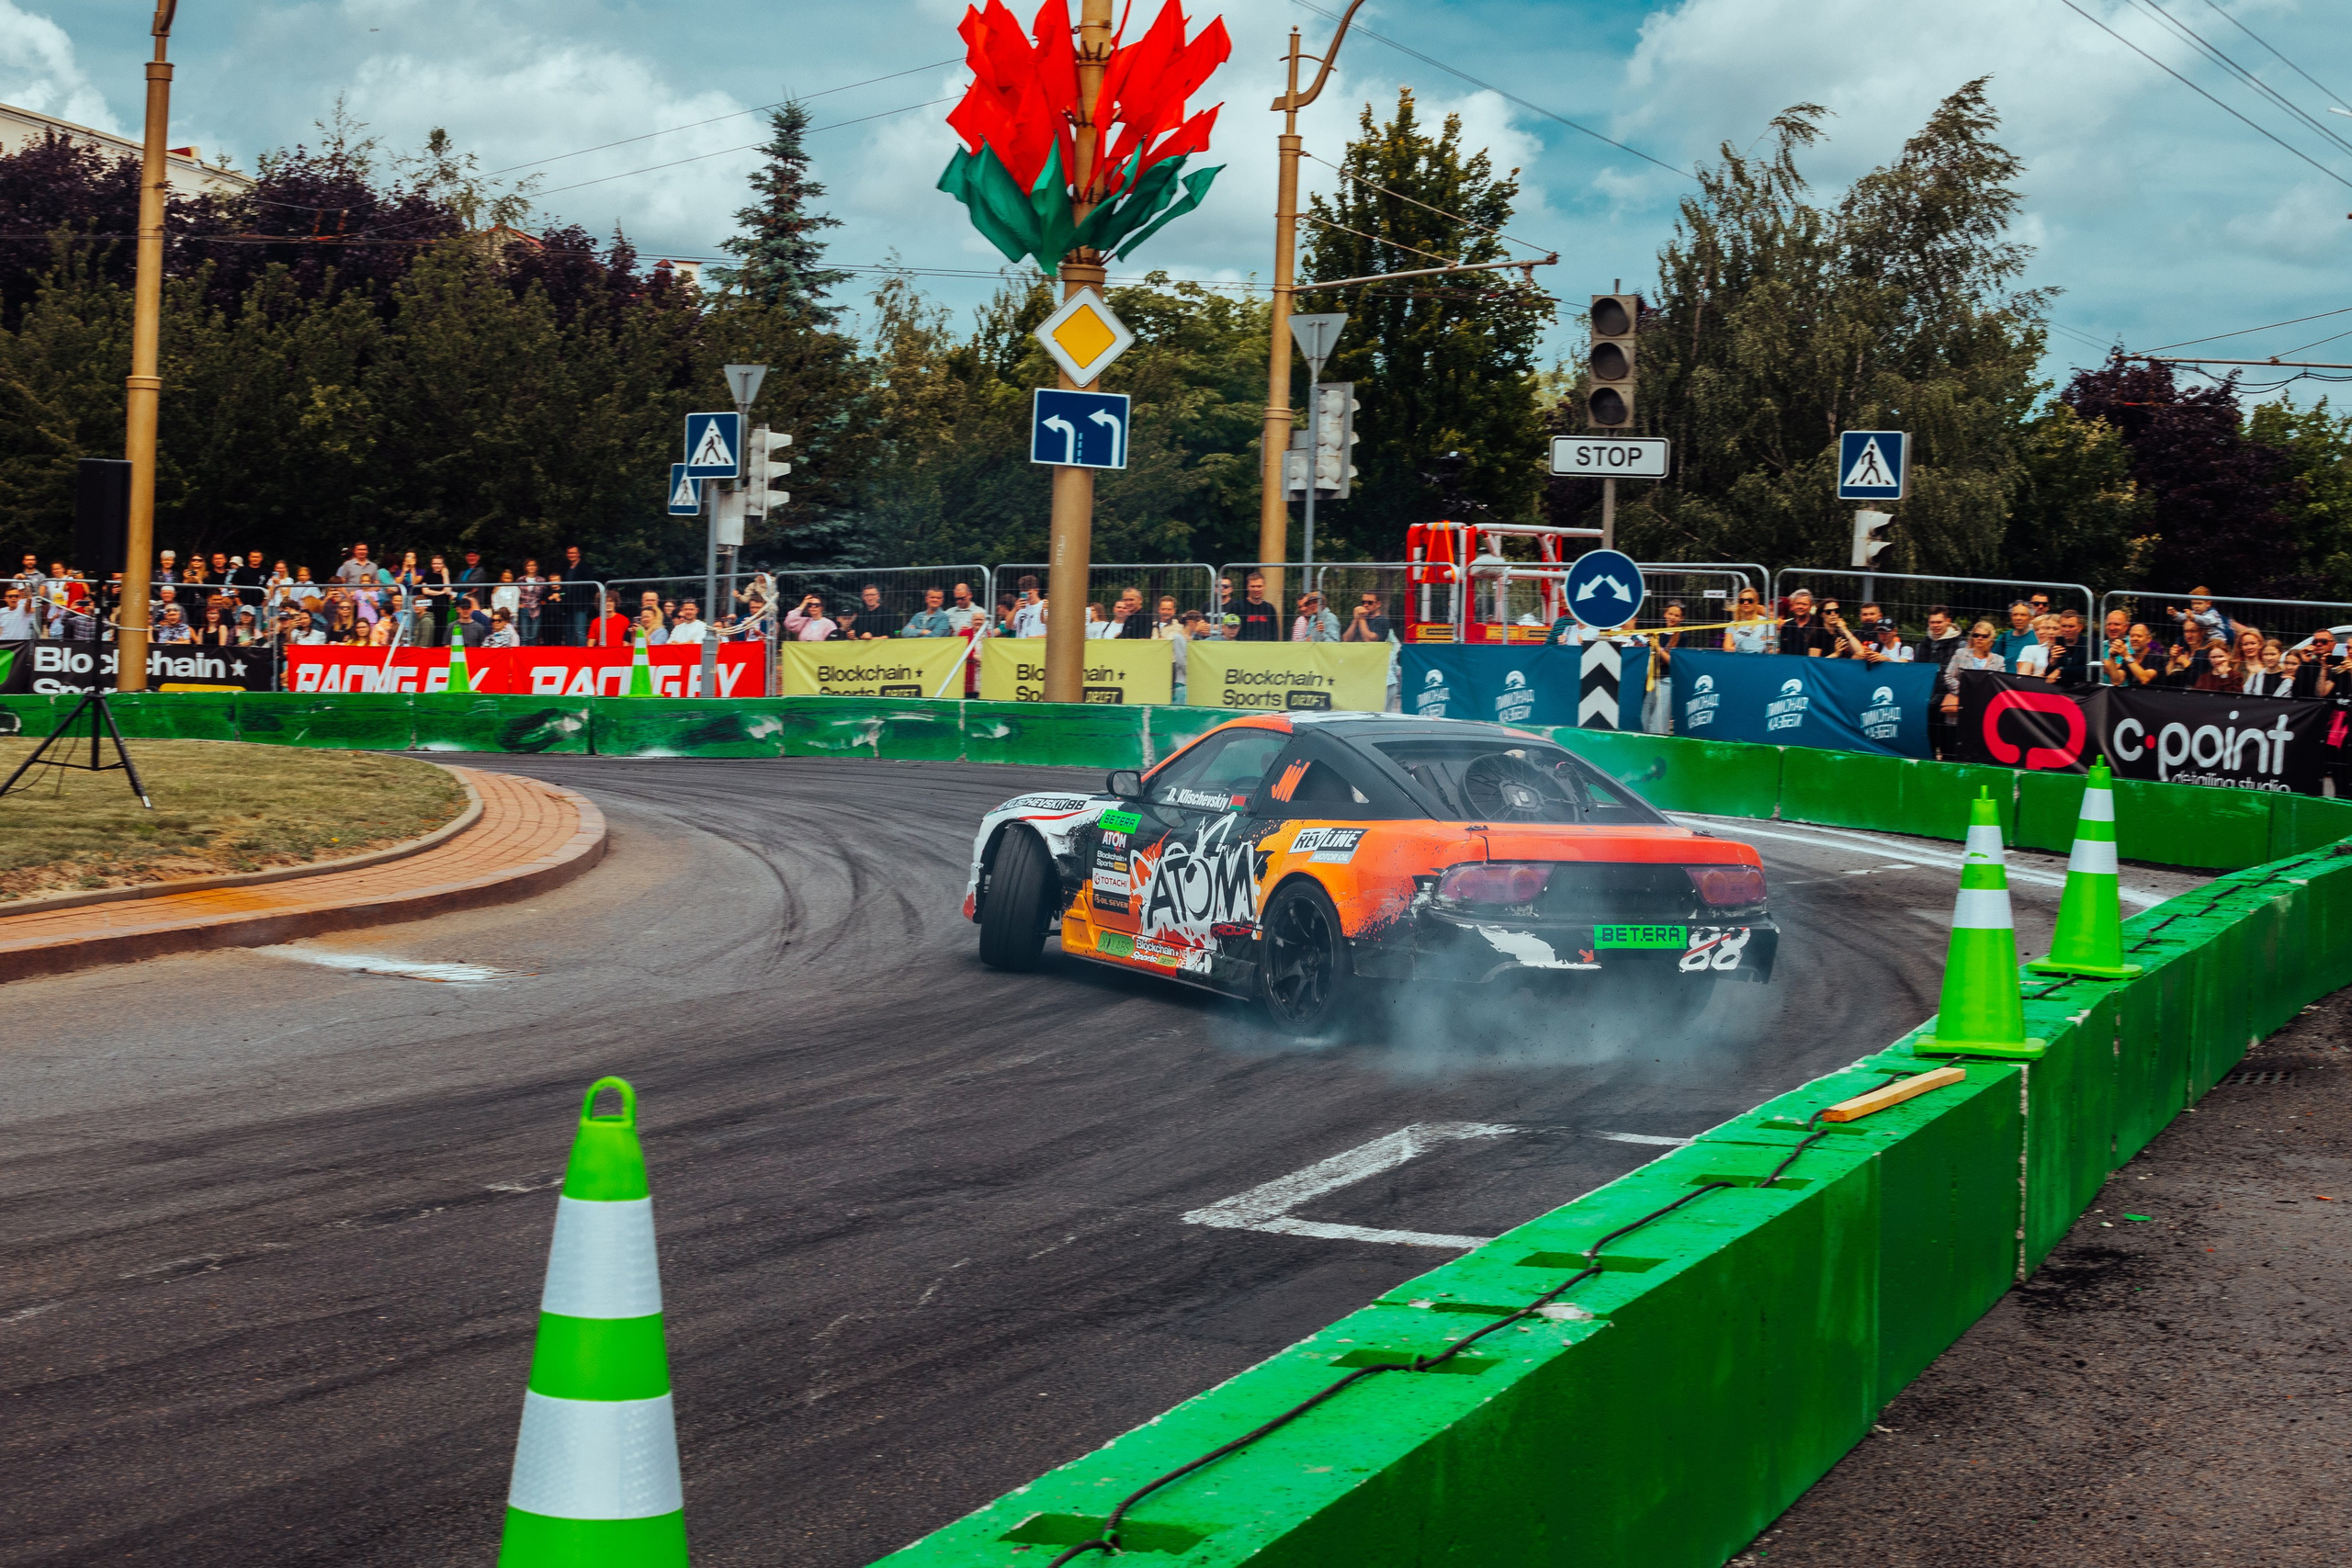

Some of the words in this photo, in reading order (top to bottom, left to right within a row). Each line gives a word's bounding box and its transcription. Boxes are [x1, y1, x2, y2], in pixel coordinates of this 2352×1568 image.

[1576, 446, 1643, 468] STOP
[33, 646, 226, 679] Blochain
[529, 666, 683, 697] RACIG
[818, 664, 911, 682] Blockchain
[1225, 668, 1324, 687] Blockchain
[1223, 689, 1283, 708] Sports
[1290, 694, 1327, 707] DRIFT
[1166, 787, 1177, 802] D.
[1177, 788, 1229, 812] Klischevskiy
[1102, 830, 1127, 849] ATOM
[1096, 850, 1125, 862] Blockchain
[1096, 858, 1114, 868] Sports
[1312, 852, 1338, 861] MOTOR
[1338, 853, 1350, 862] OIL
[1101, 875, 1127, 888] TOTACHI
[1147, 842, 1255, 930] ATOM
[1109, 898, 1129, 908] SEVEN
[1136, 938, 1175, 957] Blockchain
[1679, 926, 1751, 973] 88
